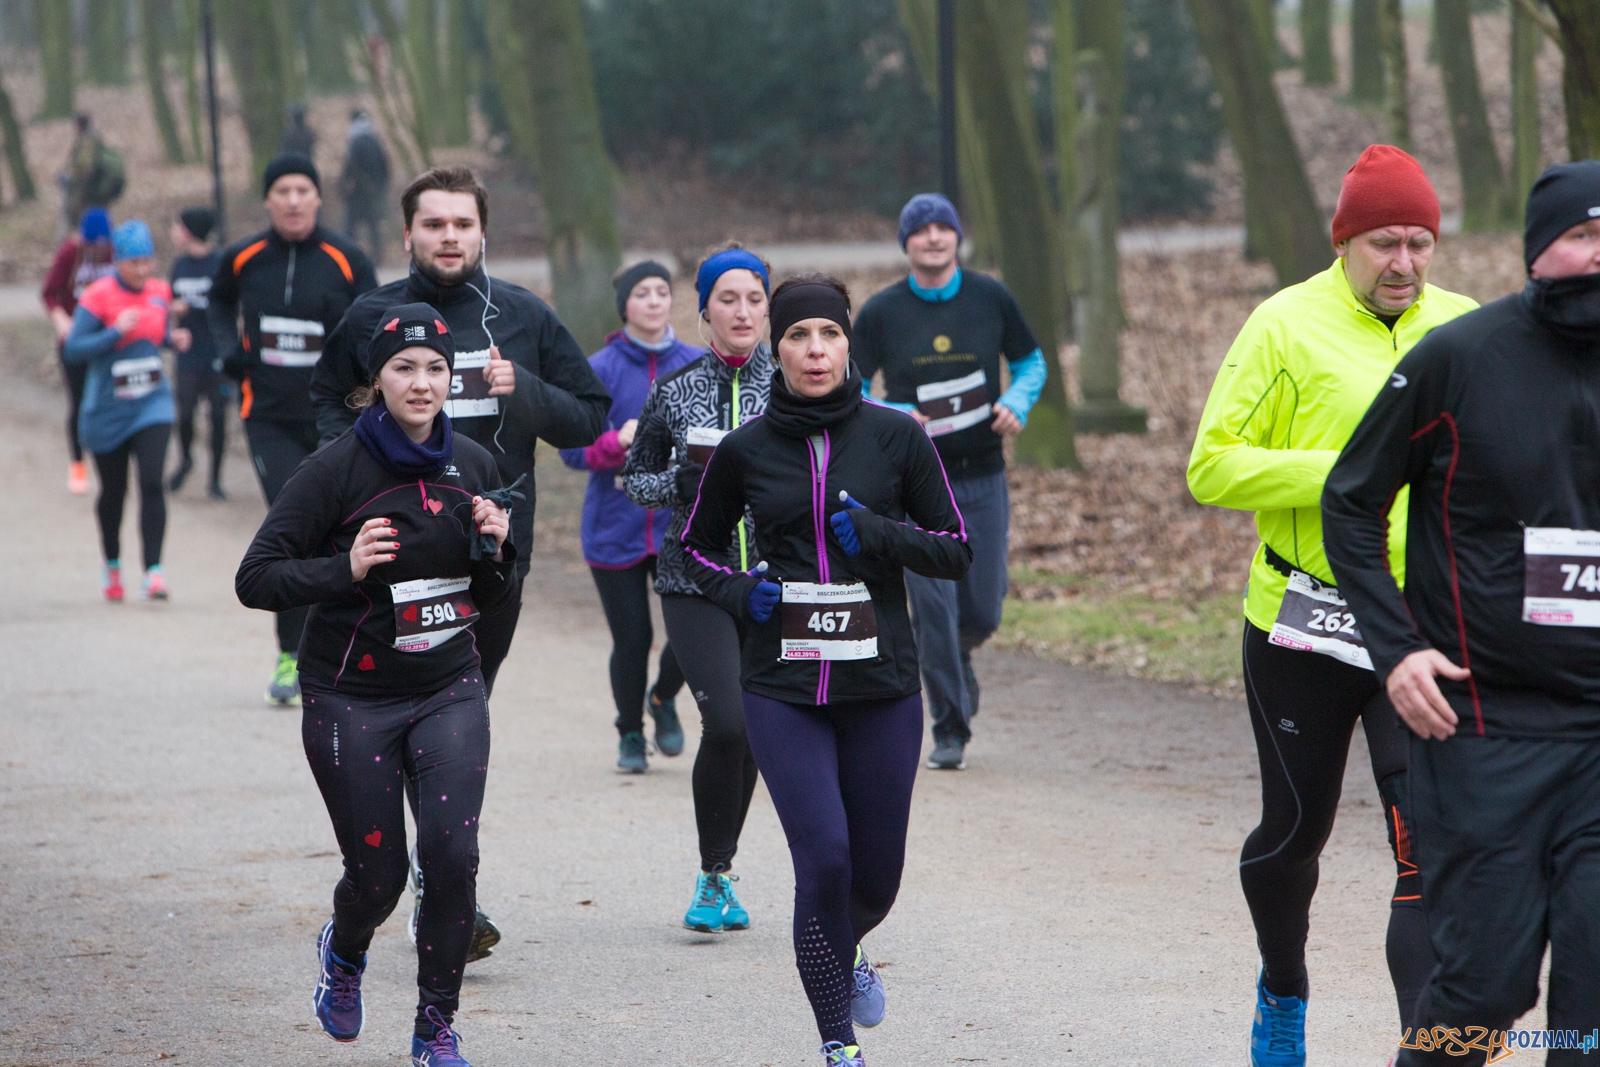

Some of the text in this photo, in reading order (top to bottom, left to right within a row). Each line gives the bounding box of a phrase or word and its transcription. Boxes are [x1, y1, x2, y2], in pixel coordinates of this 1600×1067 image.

[948, 396, 962, 413] 7
[1560, 563, 1600, 592] 74
[421, 602, 456, 627] 590
[807, 611, 851, 632] 467
[1307, 608, 1356, 635] 262
